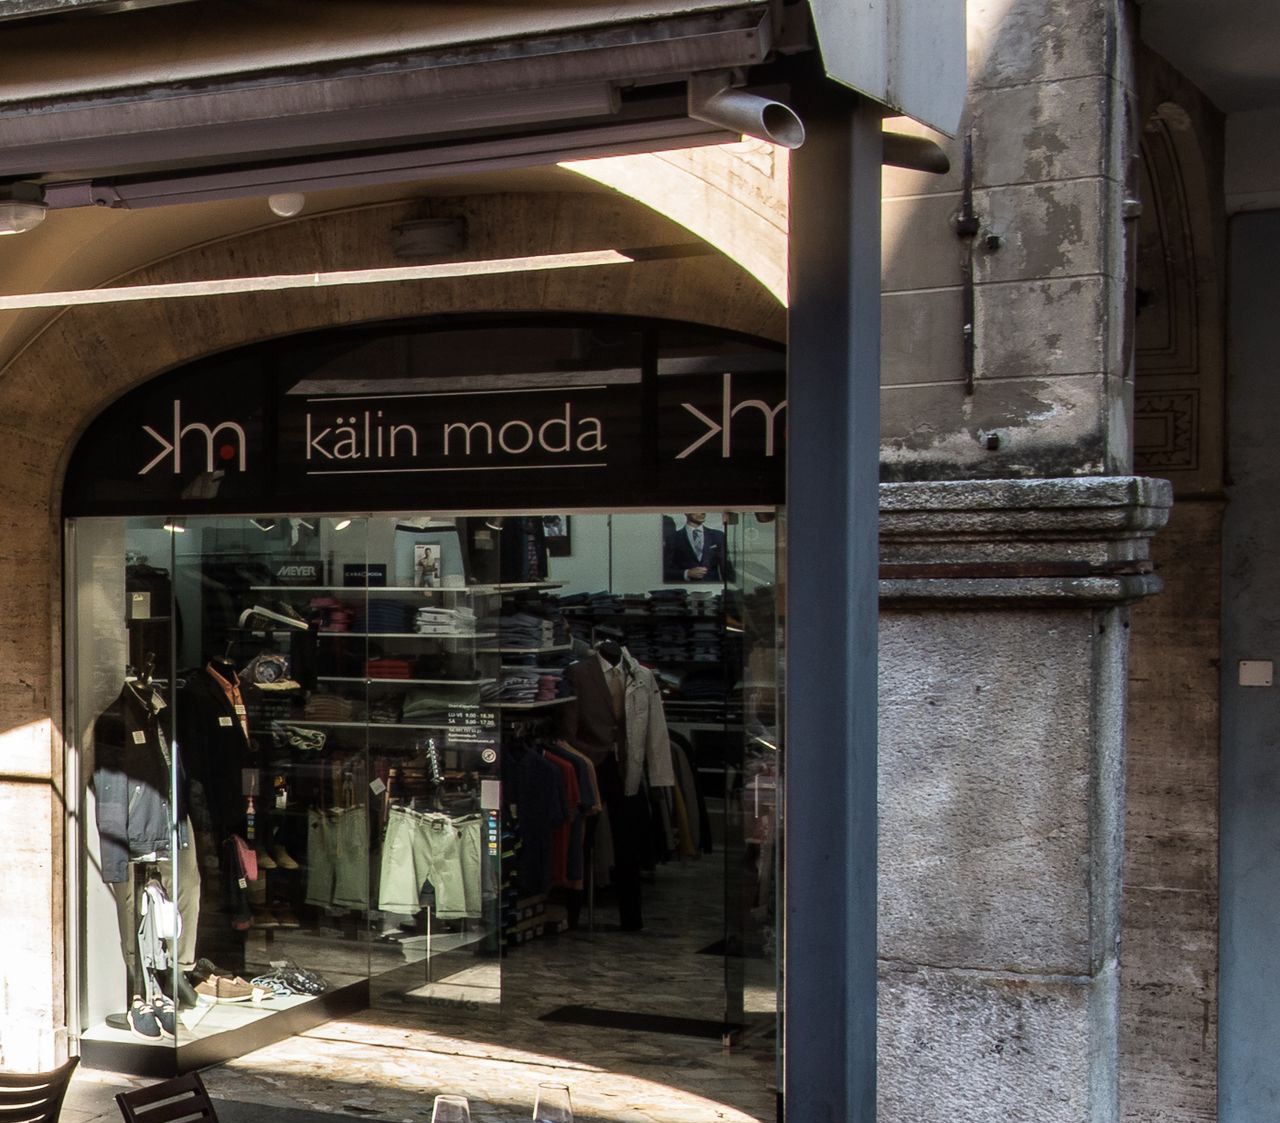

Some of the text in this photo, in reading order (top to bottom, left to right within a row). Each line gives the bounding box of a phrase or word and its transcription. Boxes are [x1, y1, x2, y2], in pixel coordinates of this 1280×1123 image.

[306, 411, 417, 460] kälin
[444, 402, 607, 455] moda
[276, 566, 316, 576] MEYER
